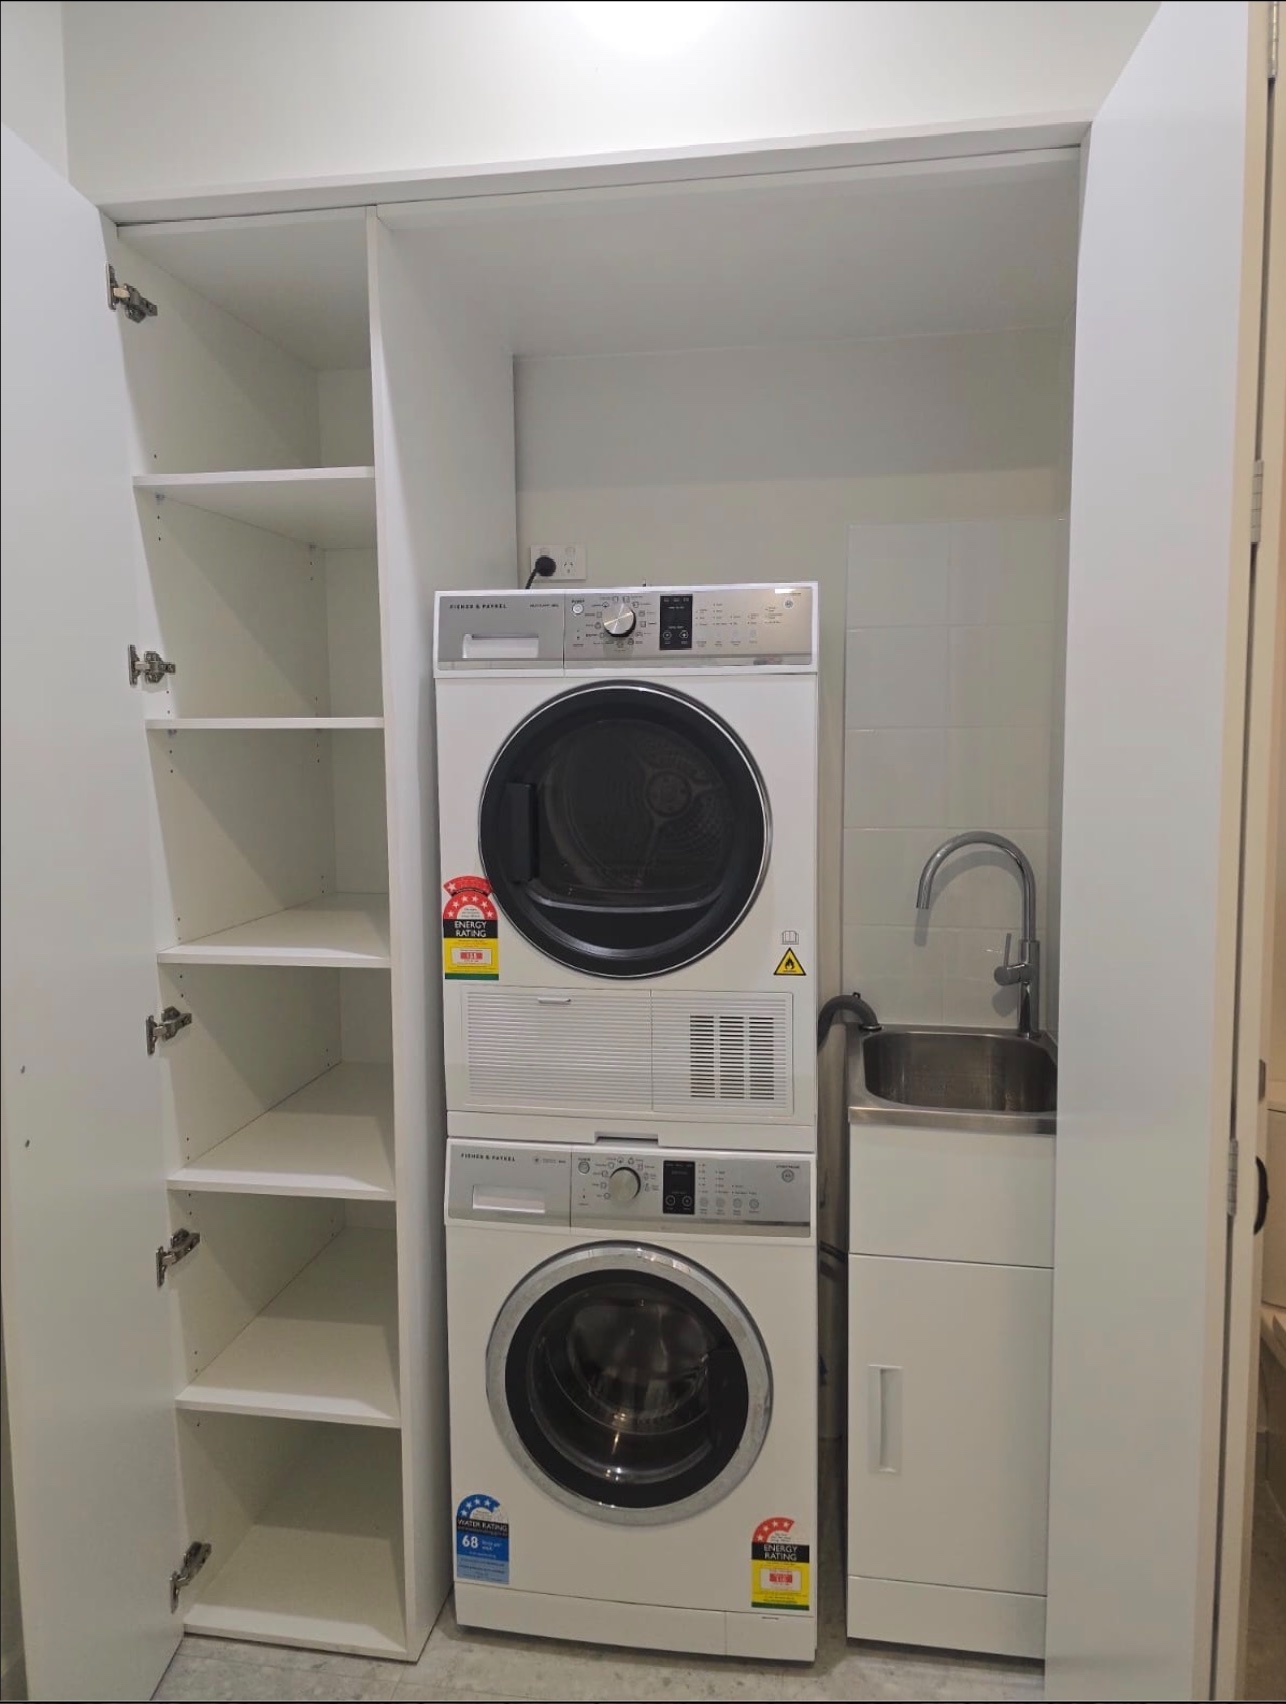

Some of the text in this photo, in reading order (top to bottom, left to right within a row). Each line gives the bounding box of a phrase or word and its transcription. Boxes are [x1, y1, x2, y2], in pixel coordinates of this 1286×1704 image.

[454, 920, 487, 929] ENERGY
[458, 1519, 507, 1531] WATER RATING
[462, 1534, 479, 1549] 68
[763, 1544, 798, 1553] ENERGY
[764, 1552, 797, 1561] RATING
